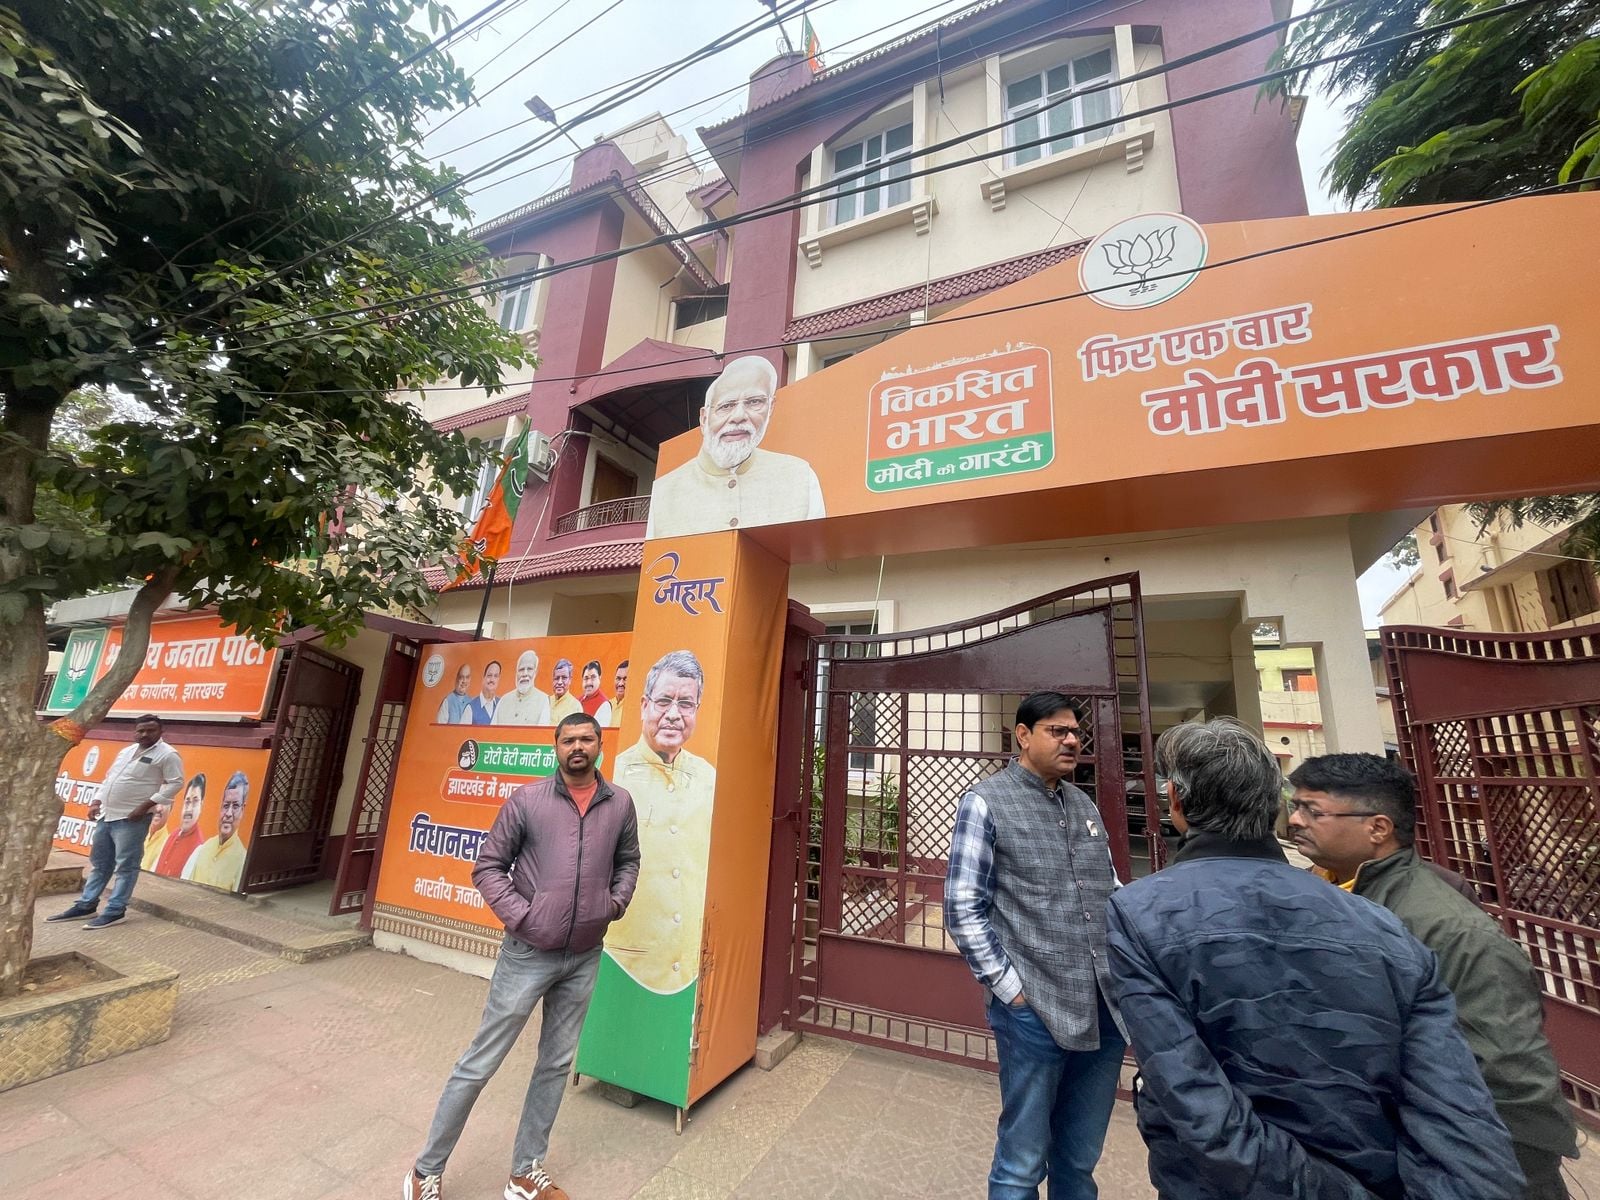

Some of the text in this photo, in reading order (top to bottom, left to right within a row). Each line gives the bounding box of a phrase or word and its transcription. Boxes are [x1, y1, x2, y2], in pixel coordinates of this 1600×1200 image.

[1077, 303, 1312, 381] फिर एक बार
[880, 365, 1037, 416] विकसित
[1141, 324, 1563, 435] मोदी सरकार
[887, 399, 1029, 449] भारत
[875, 440, 1044, 484] मोदी की गारंटी
[645, 551, 725, 616] जोहार
[165, 638, 221, 668] जनता
[182, 682, 227, 703] झारखण्ड
[484, 746, 557, 768] रोटी बेटी माटी की
[447, 776, 485, 796] झारखंड
[487, 776, 497, 798] में
[409, 812, 490, 862] विधानस
[414, 876, 453, 902] भारतीय
